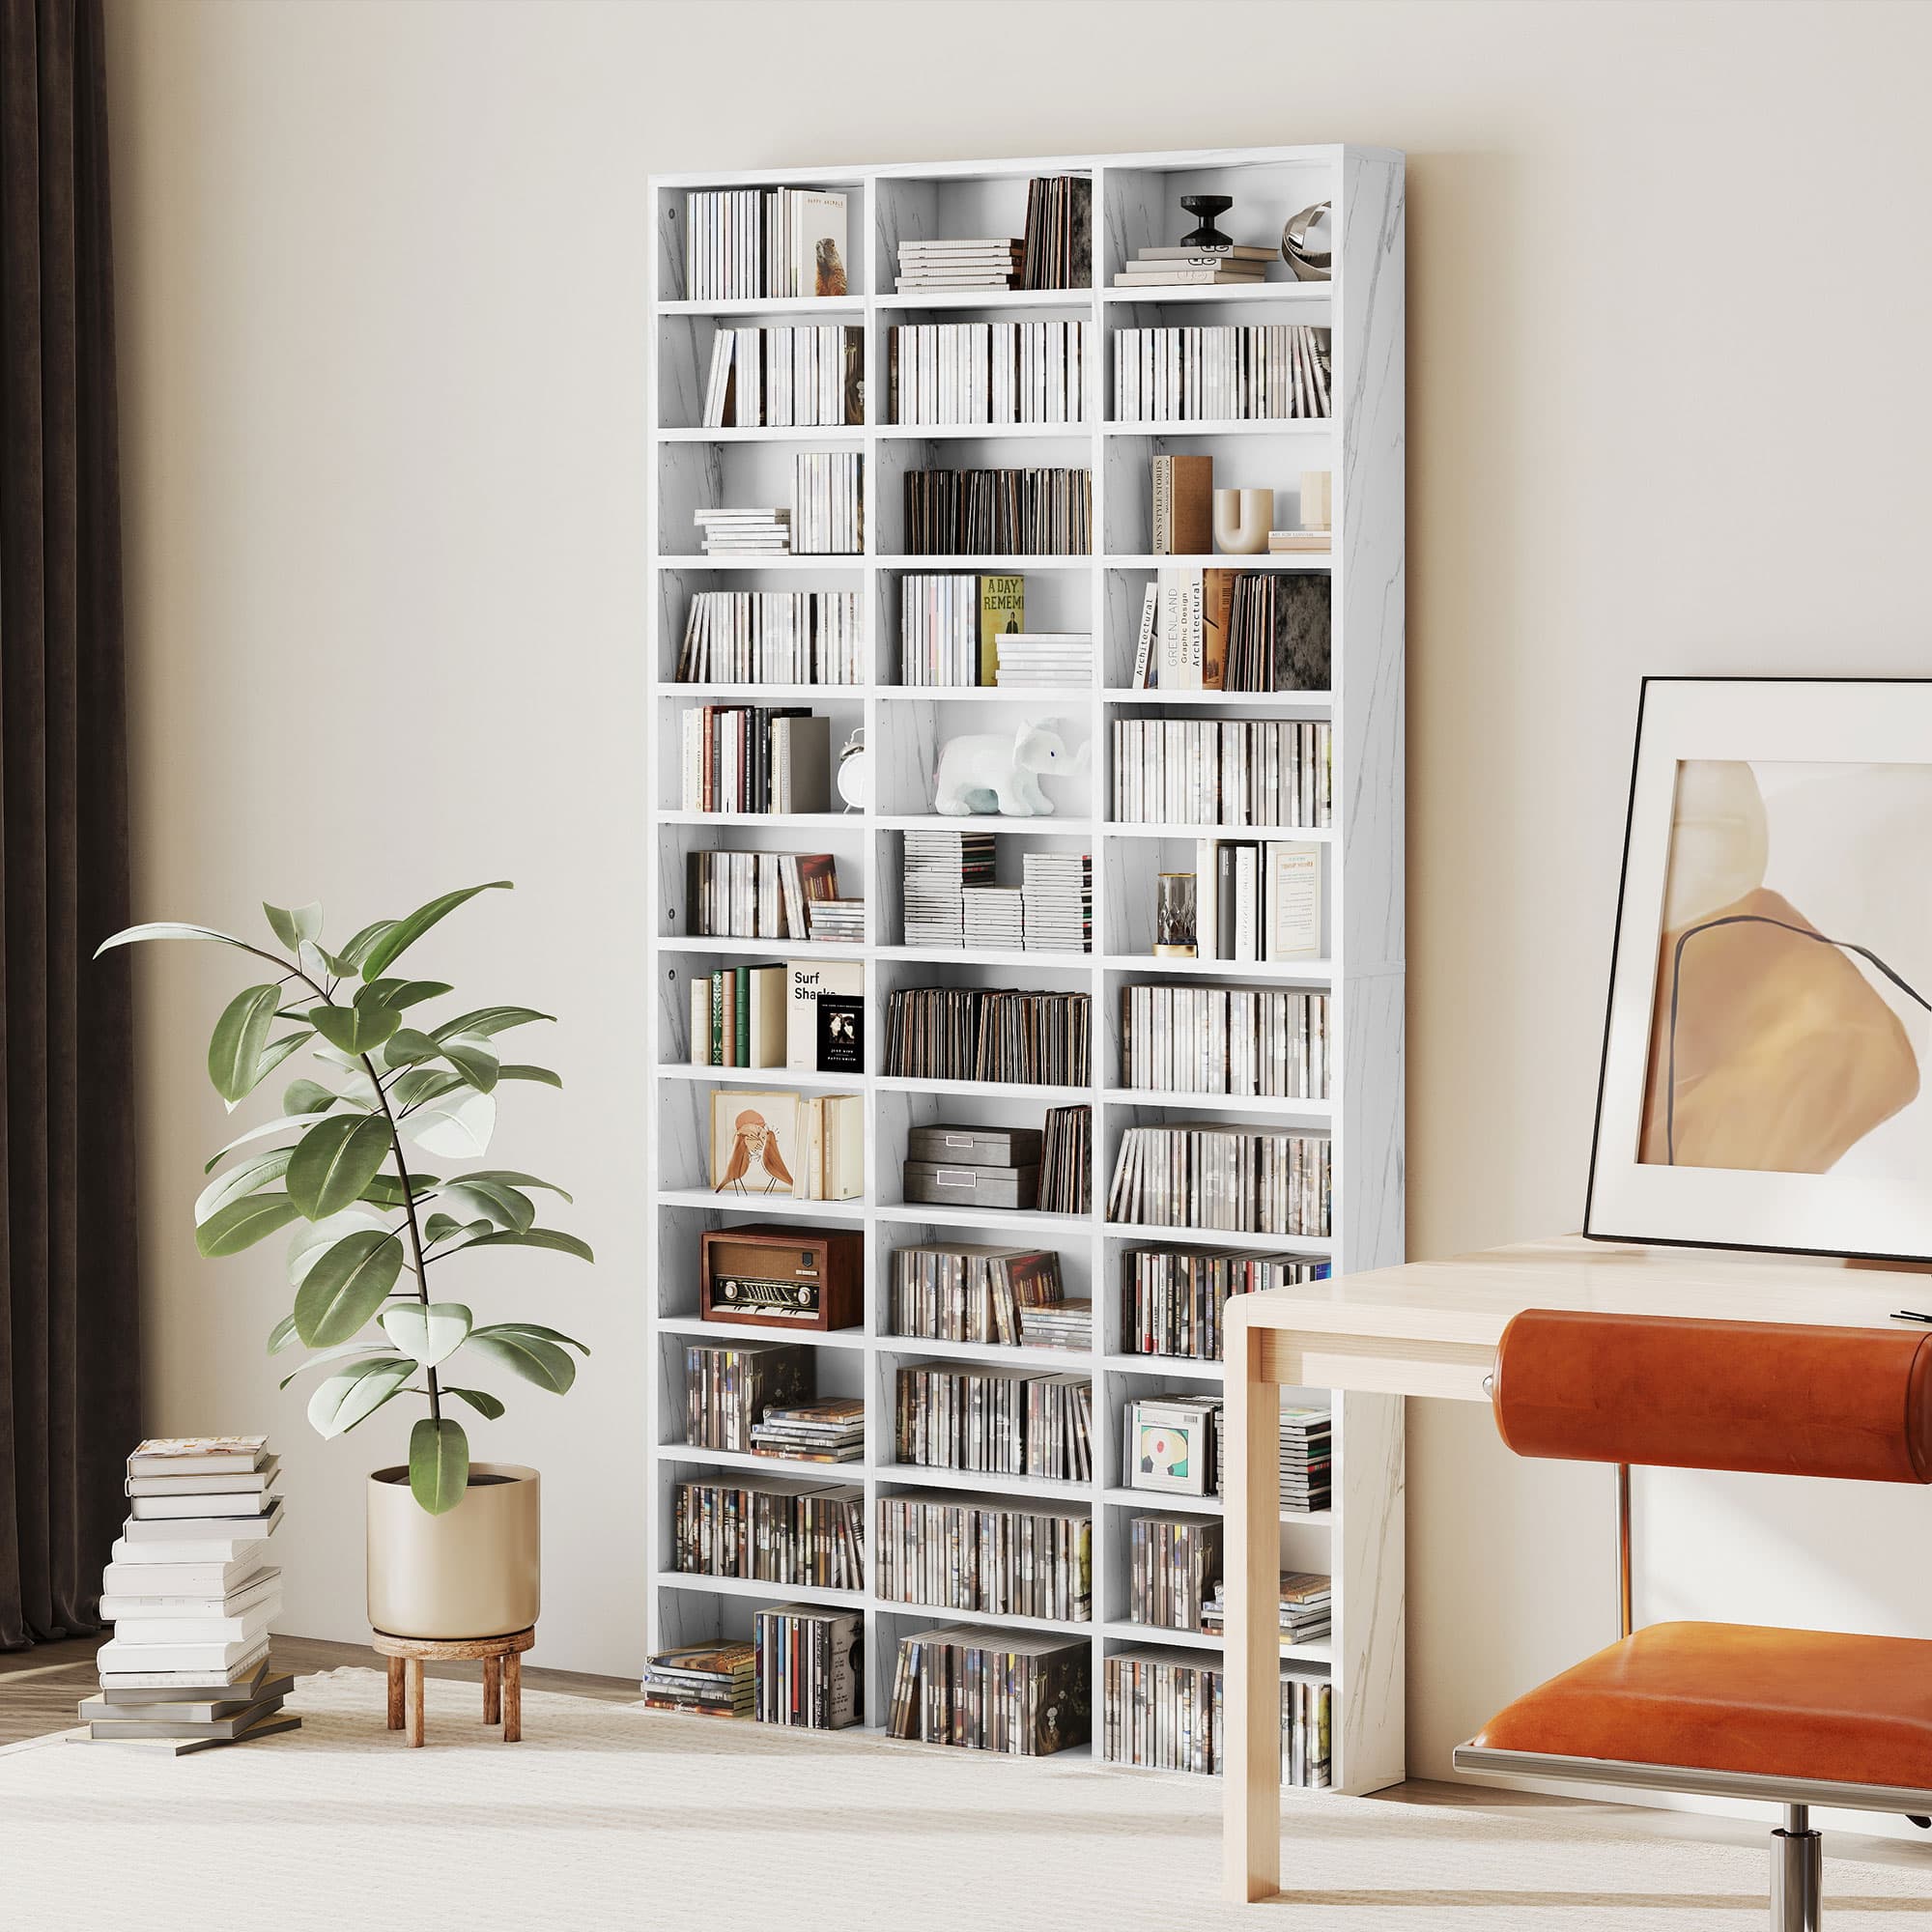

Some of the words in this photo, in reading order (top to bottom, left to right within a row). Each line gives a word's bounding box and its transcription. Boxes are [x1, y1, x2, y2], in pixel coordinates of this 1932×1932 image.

[988, 579, 995, 593] A
[997, 579, 1018, 593] DAY
[1136, 599, 1152, 676] Architectural
[1168, 588, 1178, 667] GREENLAND
[794, 972, 820, 984] Surf
